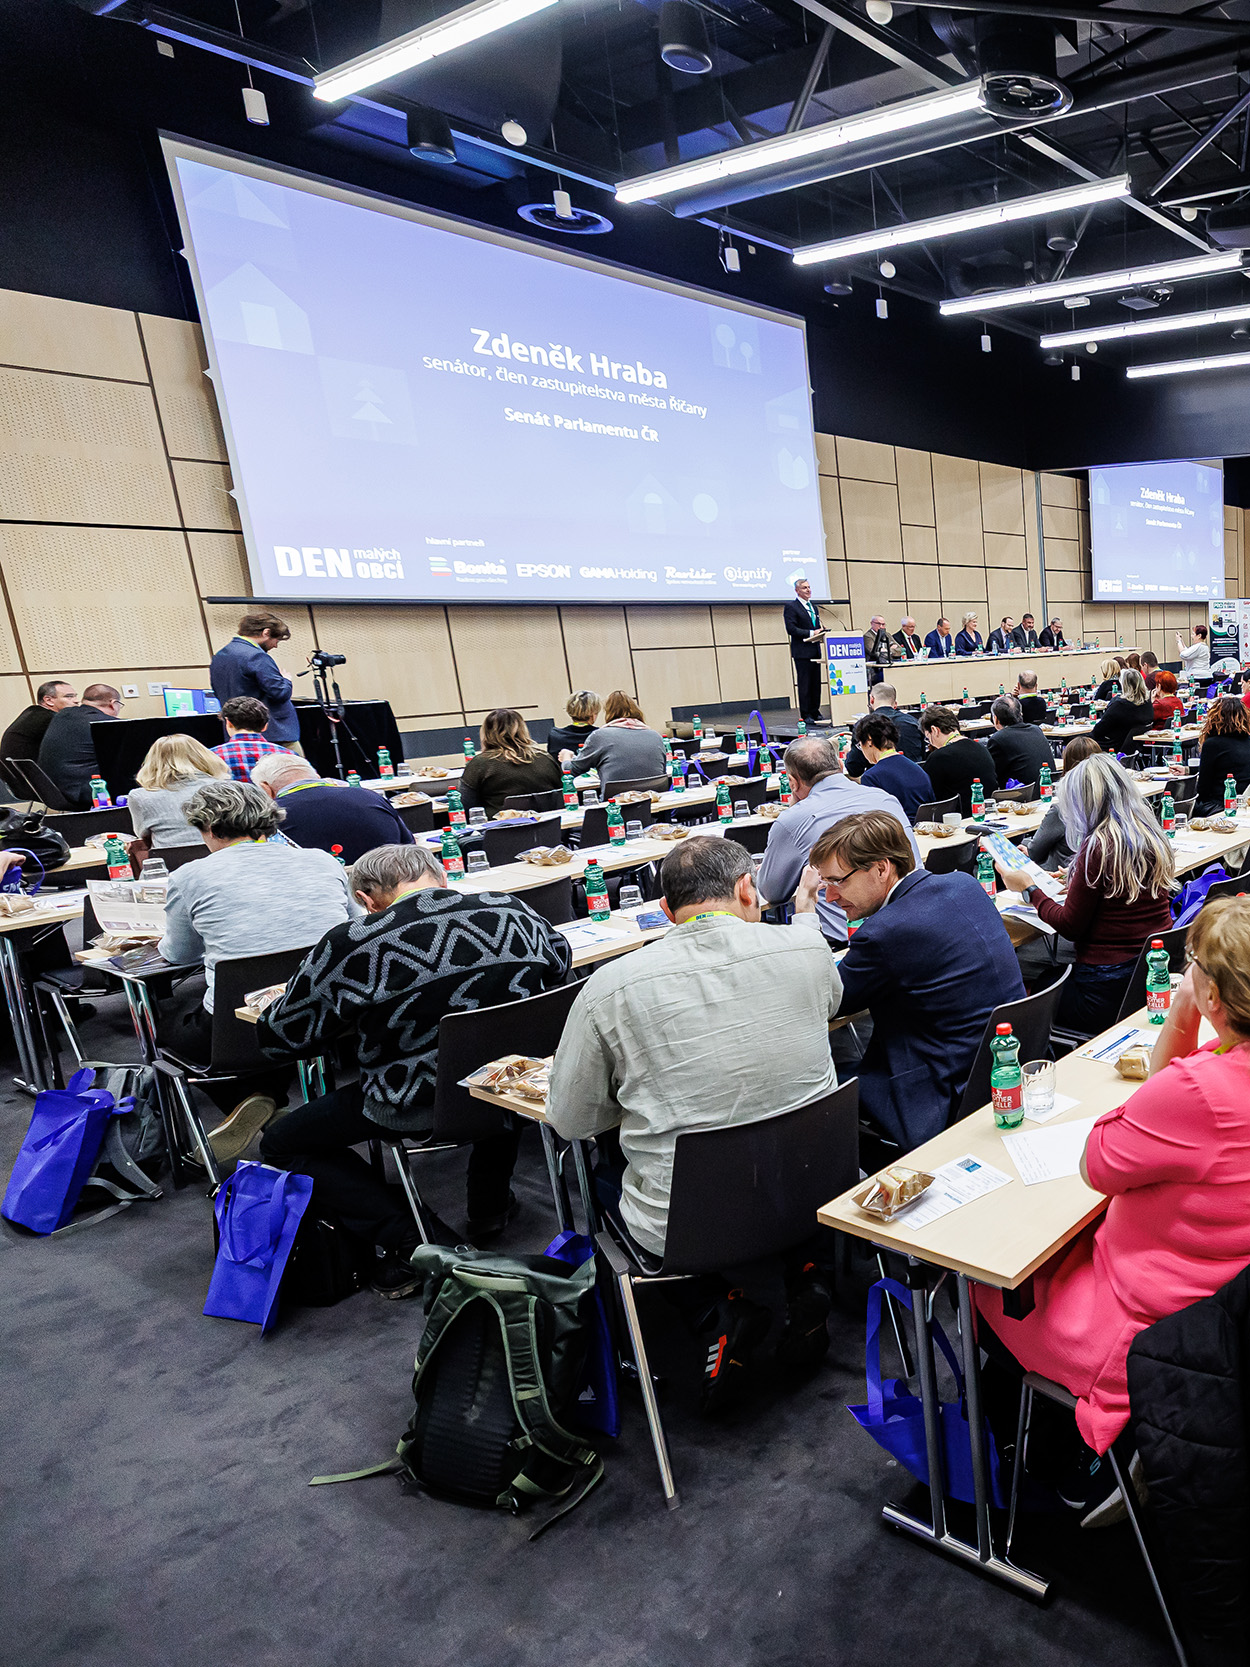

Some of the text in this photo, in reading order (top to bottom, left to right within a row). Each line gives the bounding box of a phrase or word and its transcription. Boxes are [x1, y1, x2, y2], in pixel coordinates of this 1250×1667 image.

[470, 327, 668, 390] Zdeněk Hraba
[422, 356, 708, 420] senátor, člen zastupitelstva města Říčany
[504, 406, 660, 442] Senát Parlamentu ČR
[273, 545, 405, 580] DEN OBCÍ
[353, 547, 401, 562] malých
[516, 563, 571, 579] EPSON
[829, 644, 849, 657] DEN
